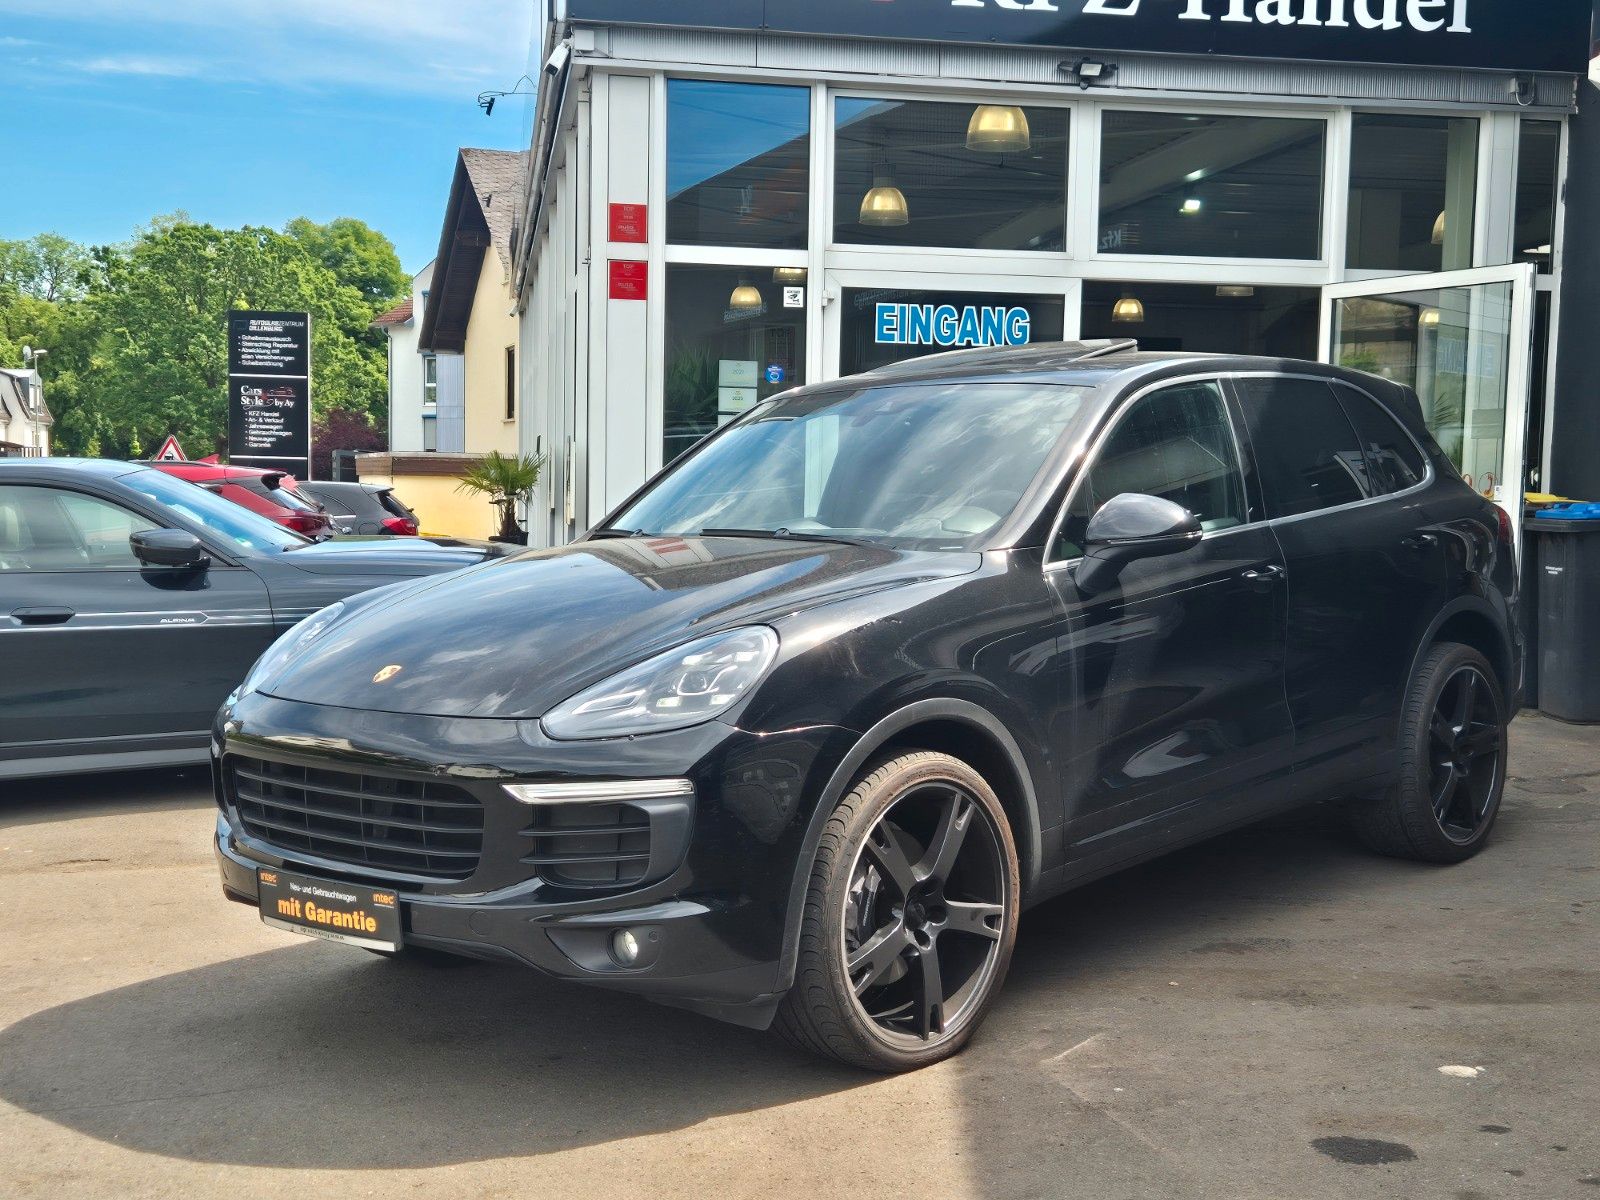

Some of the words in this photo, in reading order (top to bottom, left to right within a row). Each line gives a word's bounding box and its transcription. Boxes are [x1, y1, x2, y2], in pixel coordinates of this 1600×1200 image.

[875, 302, 1030, 347] EINGANG
[241, 341, 272, 349] Steinschlag
[241, 347, 271, 355] Abwicklung
[240, 385, 262, 395] Cars
[240, 395, 264, 407] Style
[274, 398, 284, 408] by
[284, 398, 295, 409] Ay
[248, 429, 293, 437] Gebrauchtwagen
[290, 882, 302, 892] Neu-
[302, 886, 312, 894] und
[312, 886, 357, 903] Gebrauchtwagen
[373, 893, 395, 904] intec
[278, 897, 301, 918] mit
[305, 901, 377, 932] Garantie
